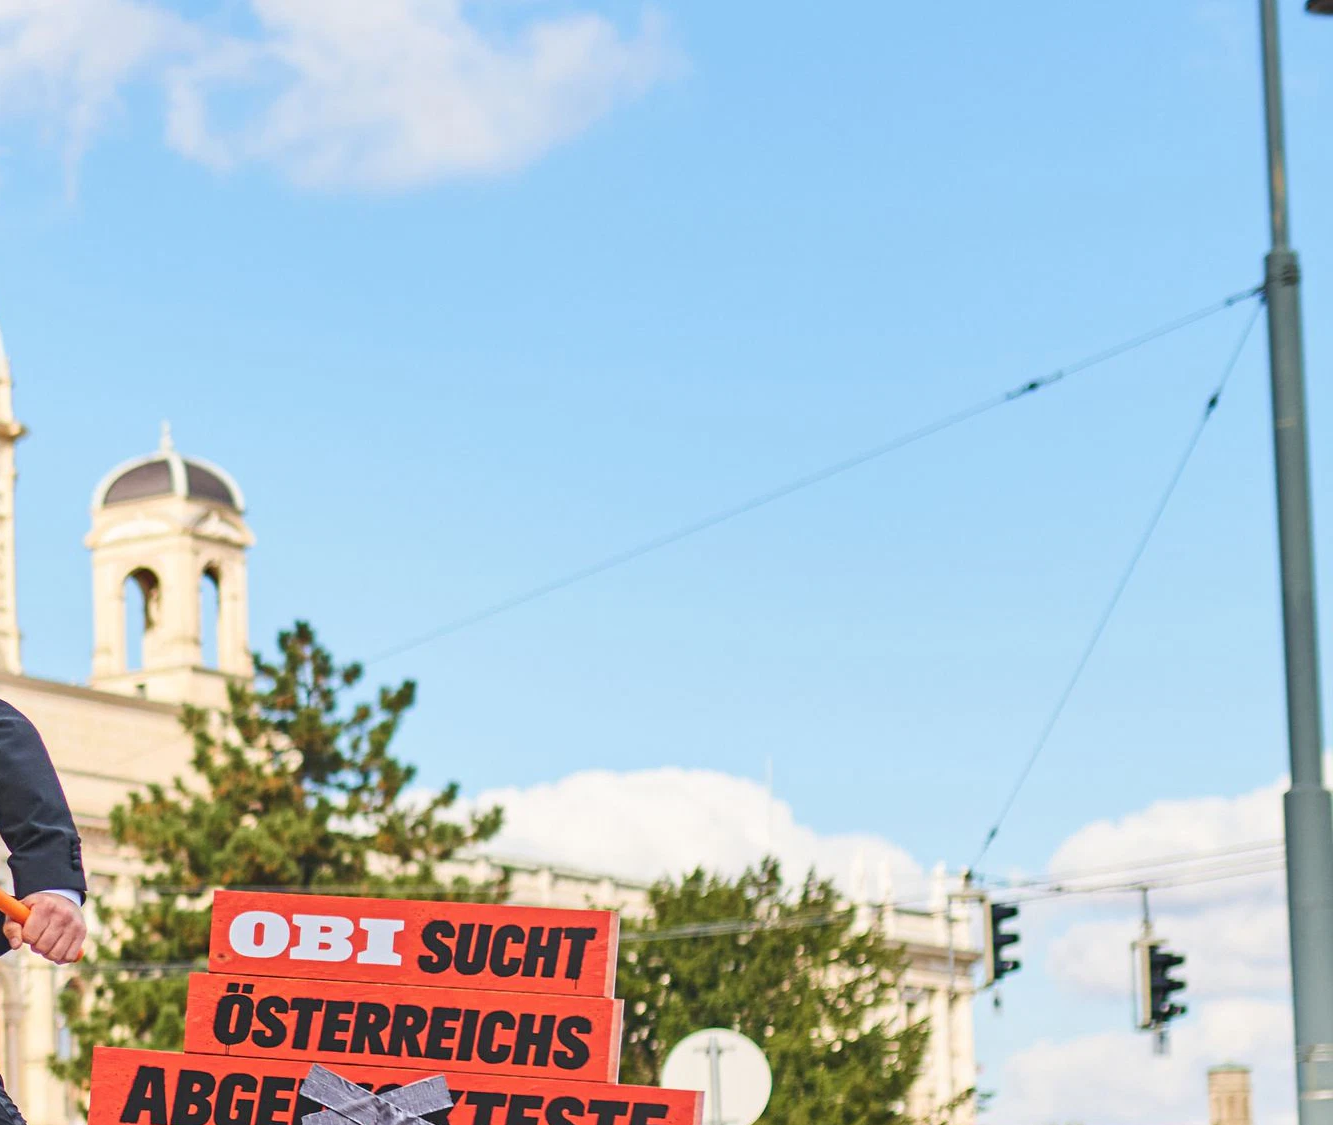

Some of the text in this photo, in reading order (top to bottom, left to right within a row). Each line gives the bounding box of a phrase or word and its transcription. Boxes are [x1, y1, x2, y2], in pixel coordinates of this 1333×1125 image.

[228, 910, 597, 981] OBI SUCHT
[212, 982, 593, 1071] ÖSTERREICHS
